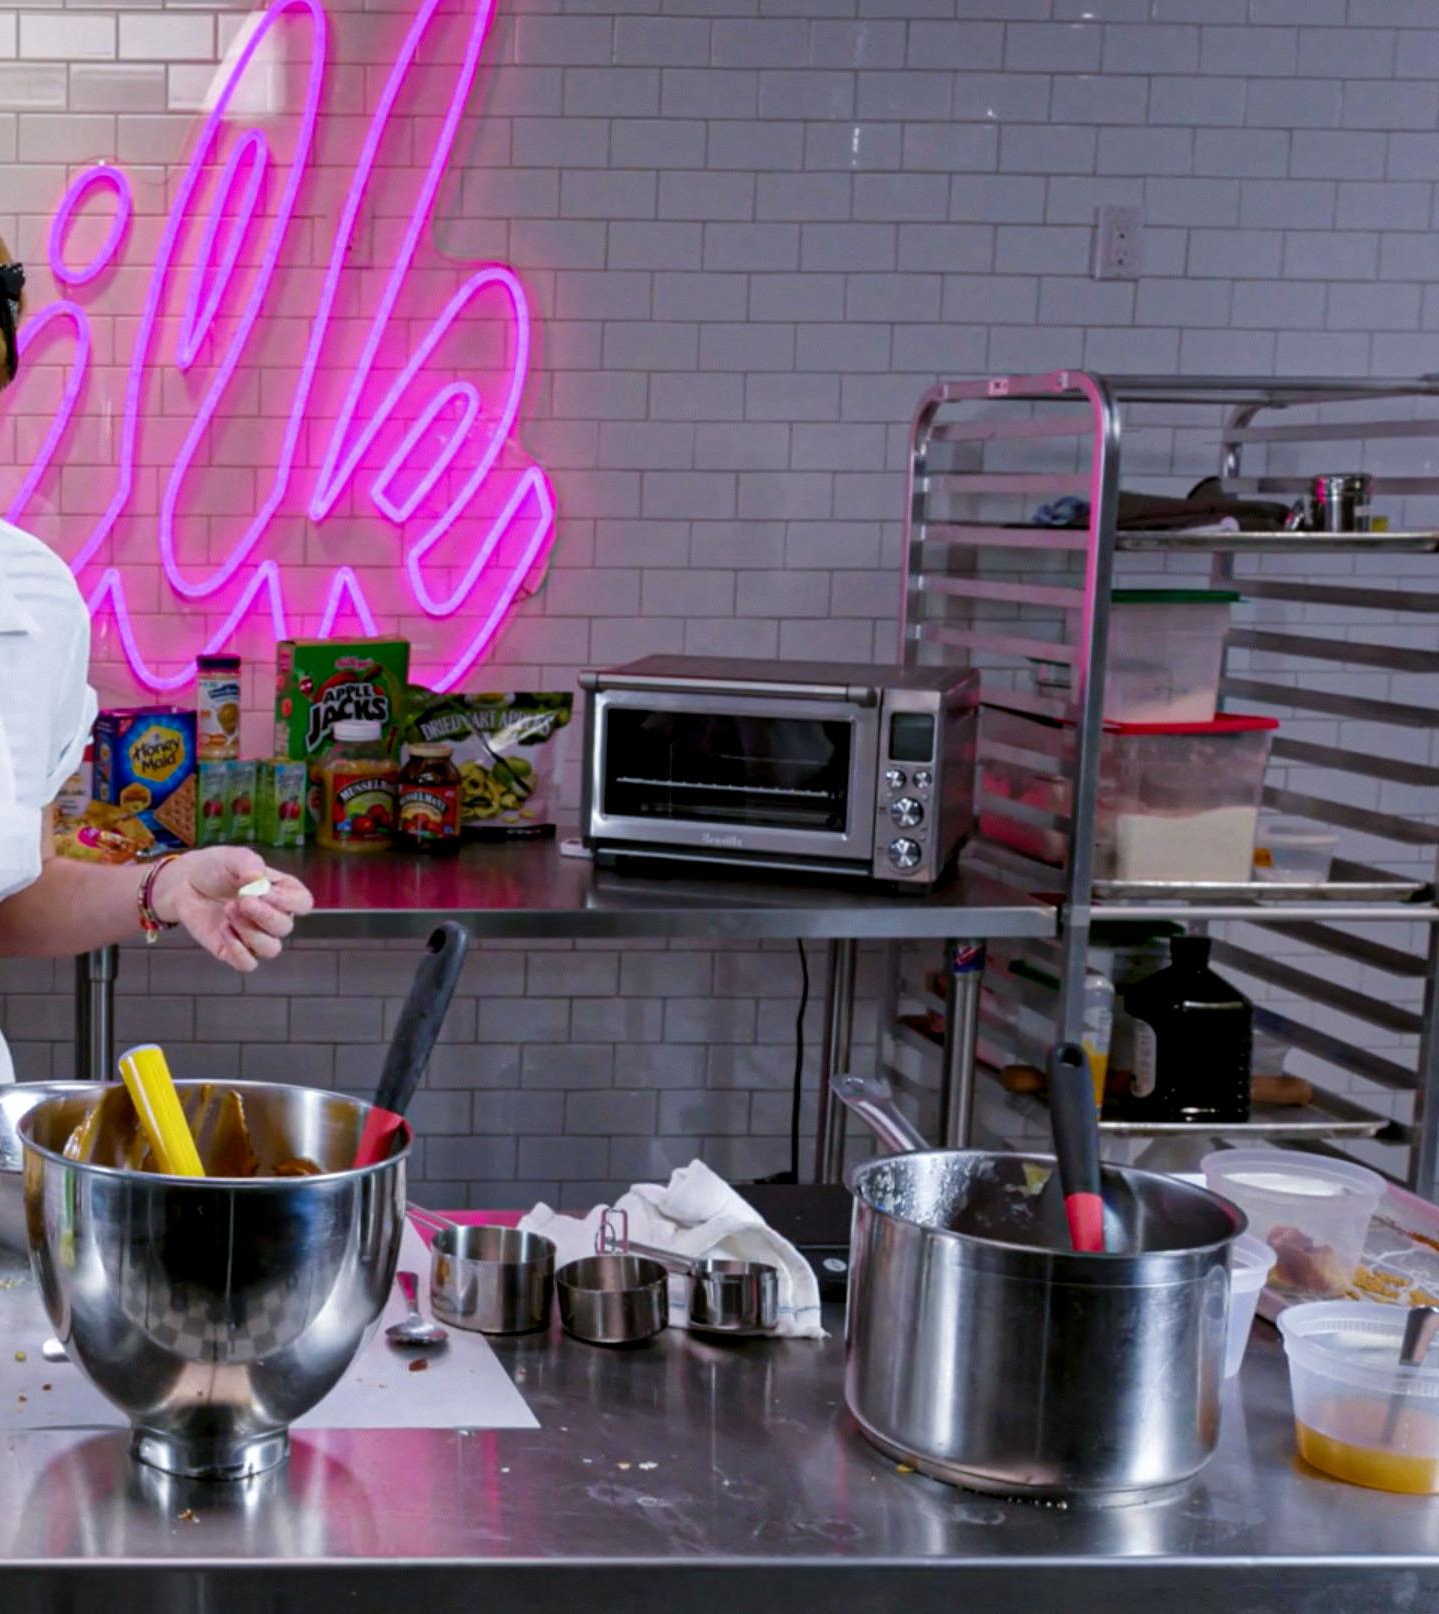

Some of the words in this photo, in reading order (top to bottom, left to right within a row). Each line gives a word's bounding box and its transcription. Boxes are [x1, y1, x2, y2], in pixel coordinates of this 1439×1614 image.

[323, 684, 373, 703] APPLE
[306, 697, 388, 751] JACKS
[419, 714, 463, 741] DRIED
[133, 738, 180, 762] Honey
[141, 753, 177, 774] Maid
